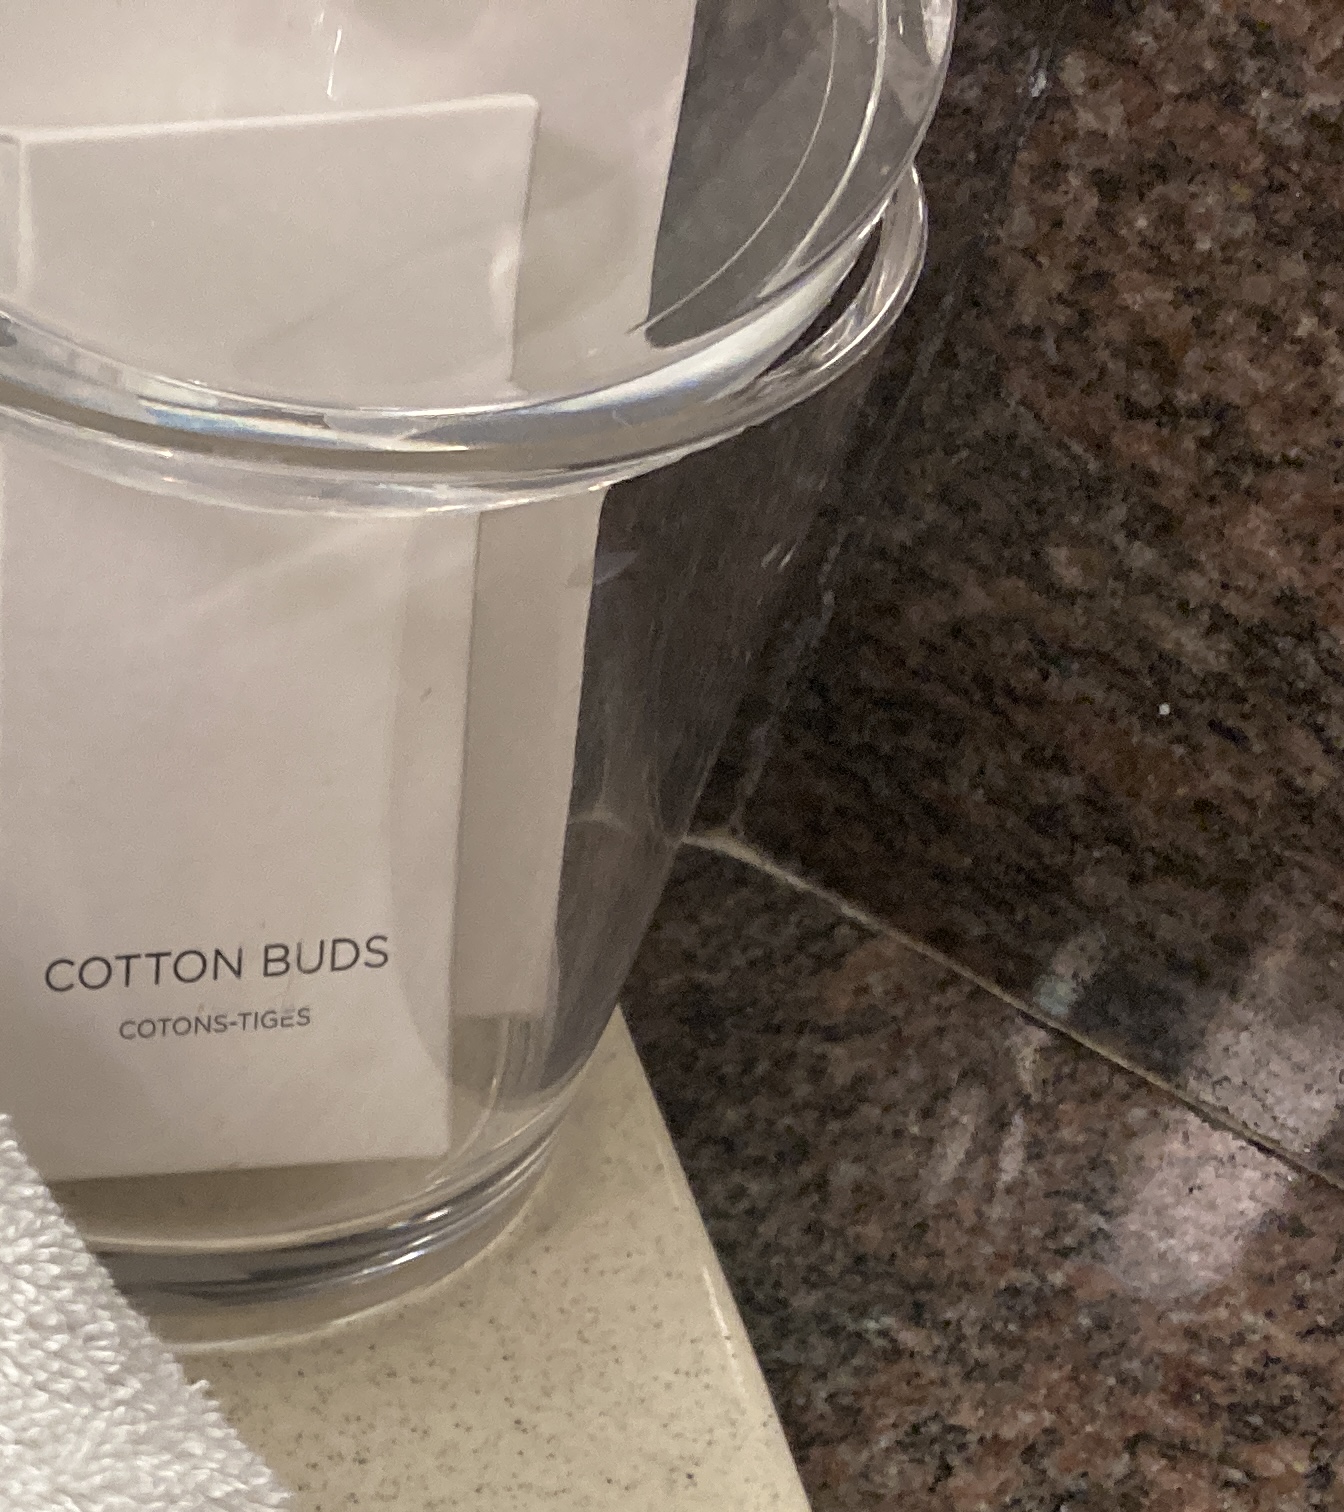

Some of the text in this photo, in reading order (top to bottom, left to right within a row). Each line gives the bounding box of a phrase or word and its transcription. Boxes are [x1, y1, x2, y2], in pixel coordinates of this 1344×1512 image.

[44, 934, 390, 993] COTTON BUDS
[118, 1007, 312, 1041] COTONS-TIGES
